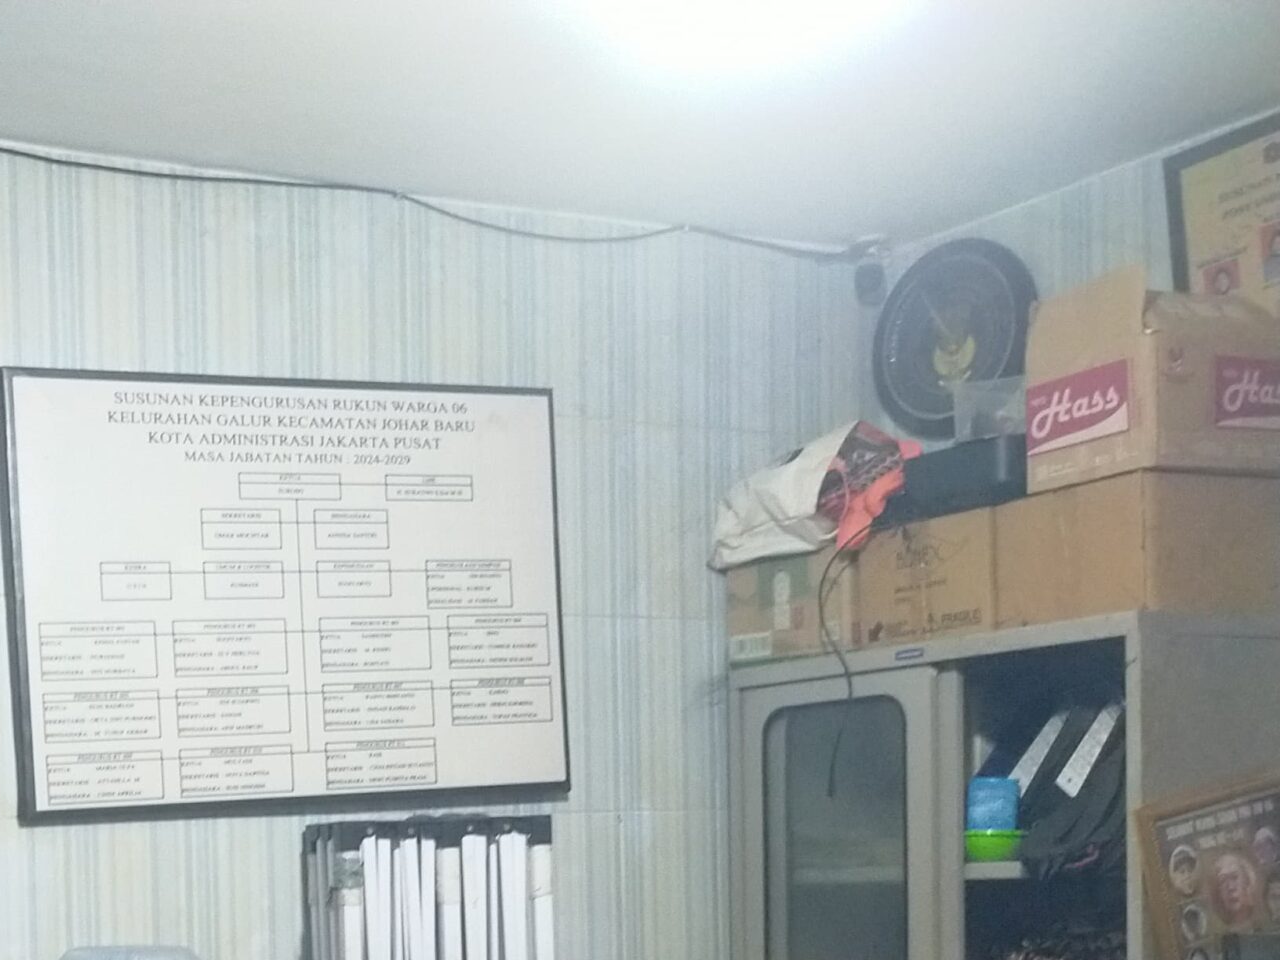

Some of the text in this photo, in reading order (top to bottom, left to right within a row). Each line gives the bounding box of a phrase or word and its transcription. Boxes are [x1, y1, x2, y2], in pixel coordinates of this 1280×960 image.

[113, 391, 468, 415] SUSUNAN KEPENGURUSAN RUKUN WARGA 06
[1031, 386, 1120, 439] Hass
[107, 411, 476, 433] KELURAHAN GALUR KECAMATAN JOHAR BARU
[148, 431, 443, 450] KOTA ADMINISTRASI JAKARTA PUSAT
[184, 451, 225, 463] MASA
[228, 451, 292, 464] JABATAN
[296, 453, 343, 465] TAHUN
[353, 454, 412, 466] 2024-2029
